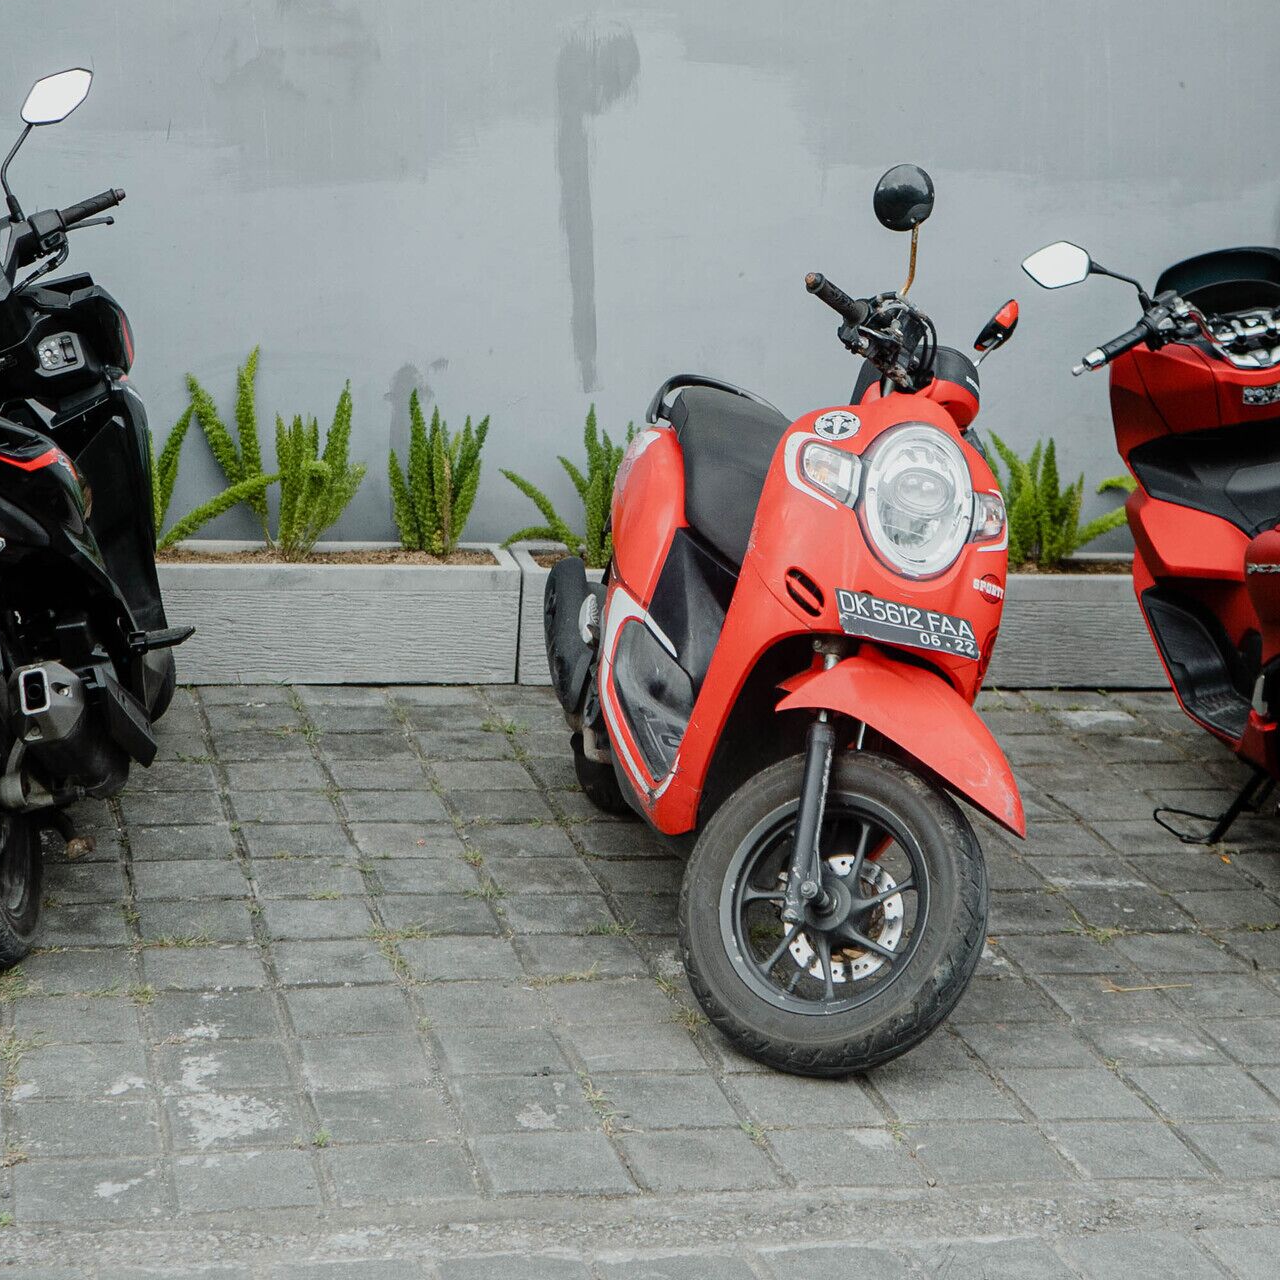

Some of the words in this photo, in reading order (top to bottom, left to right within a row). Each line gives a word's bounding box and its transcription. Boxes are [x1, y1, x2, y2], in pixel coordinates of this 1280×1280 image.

[839, 591, 871, 617] DK
[871, 599, 923, 629] 5612
[926, 612, 975, 640] FAA
